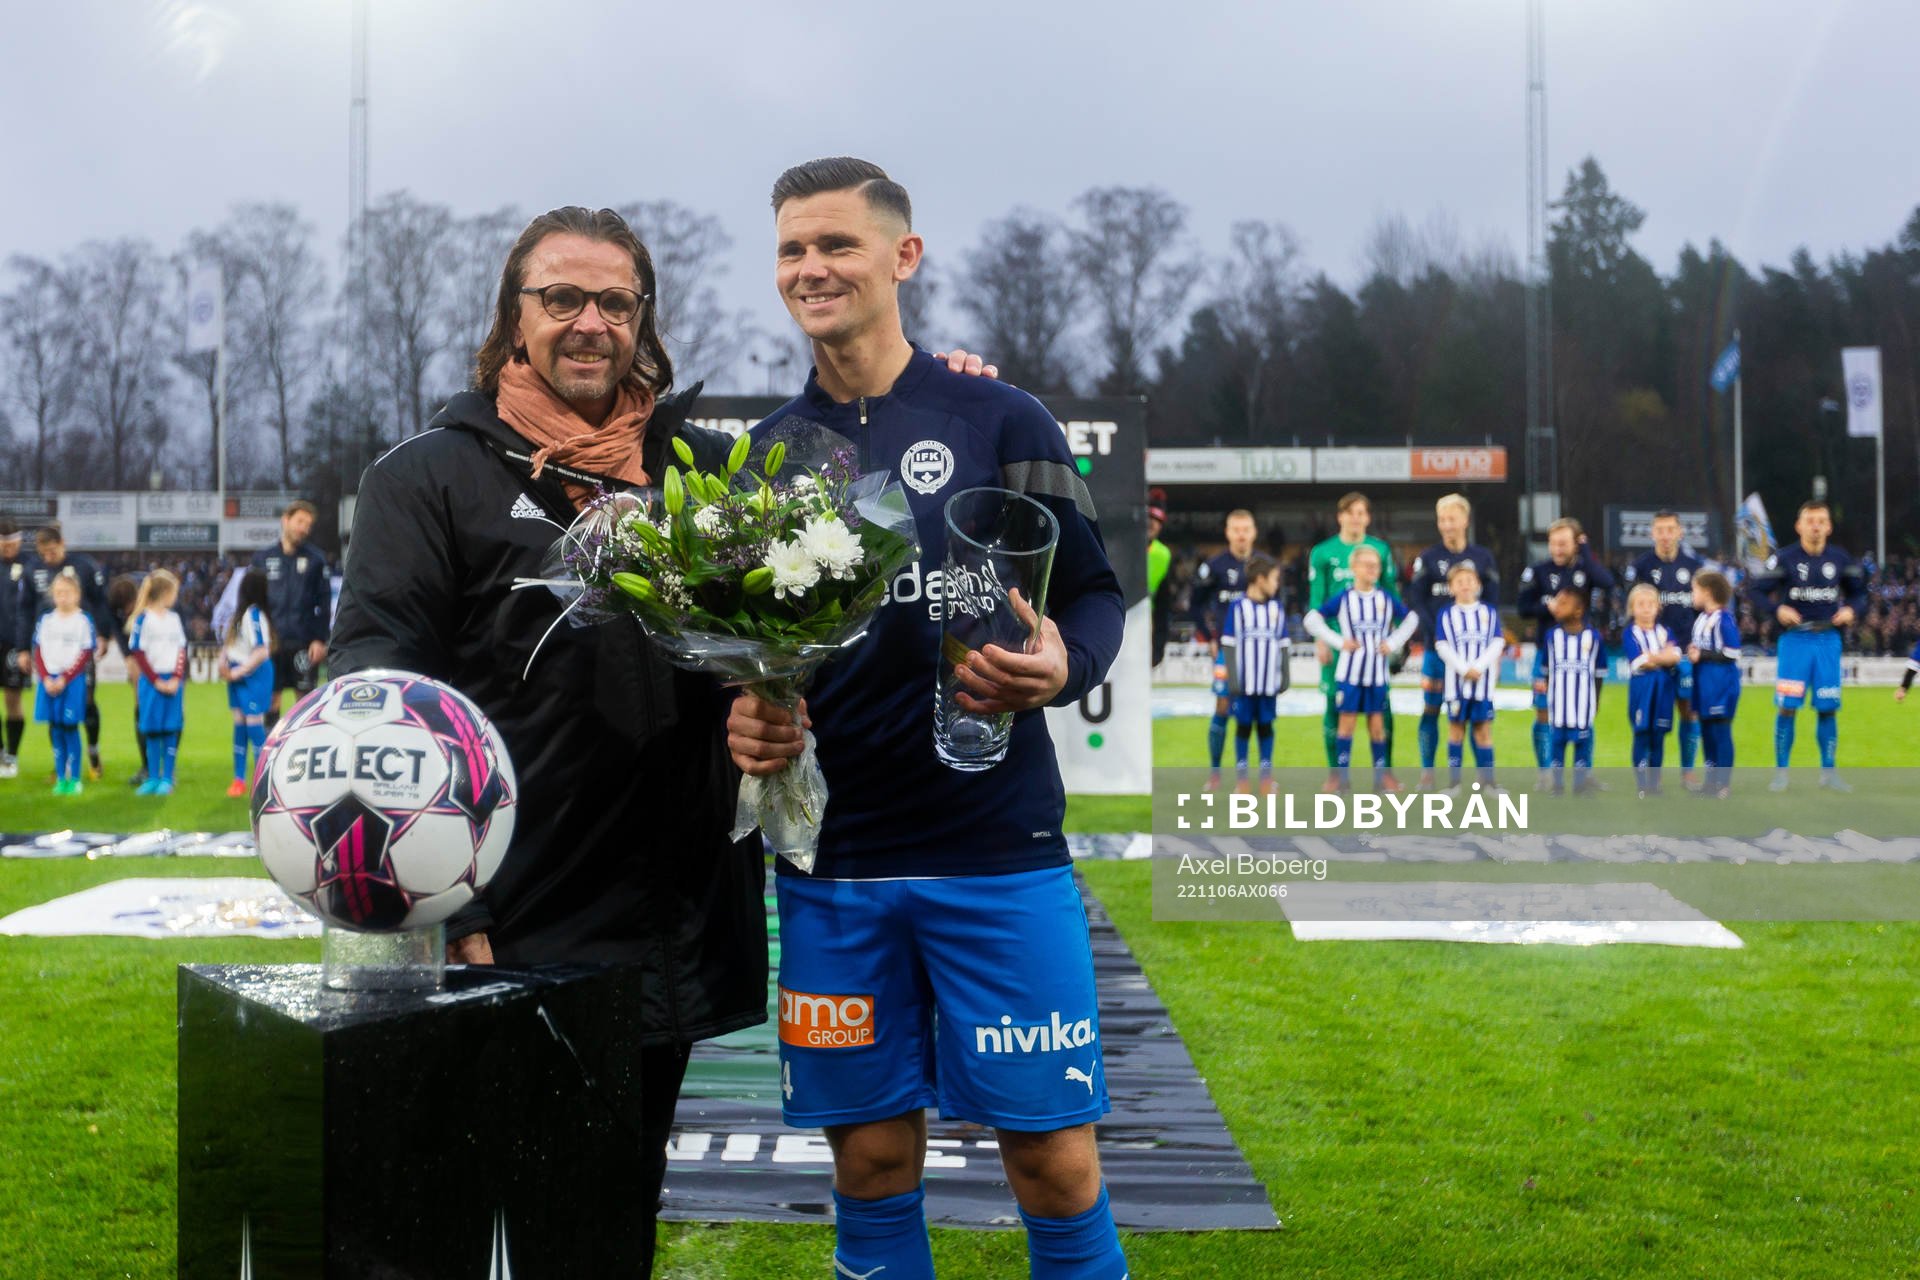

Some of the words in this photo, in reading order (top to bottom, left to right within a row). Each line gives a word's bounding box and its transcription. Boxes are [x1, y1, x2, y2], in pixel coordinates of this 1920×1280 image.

[1058, 421, 1119, 456] ET
[916, 452, 939, 461] IFK
[286, 745, 426, 784] SELECT
[779, 991, 869, 1027] amo
[807, 1028, 870, 1045] GROUP
